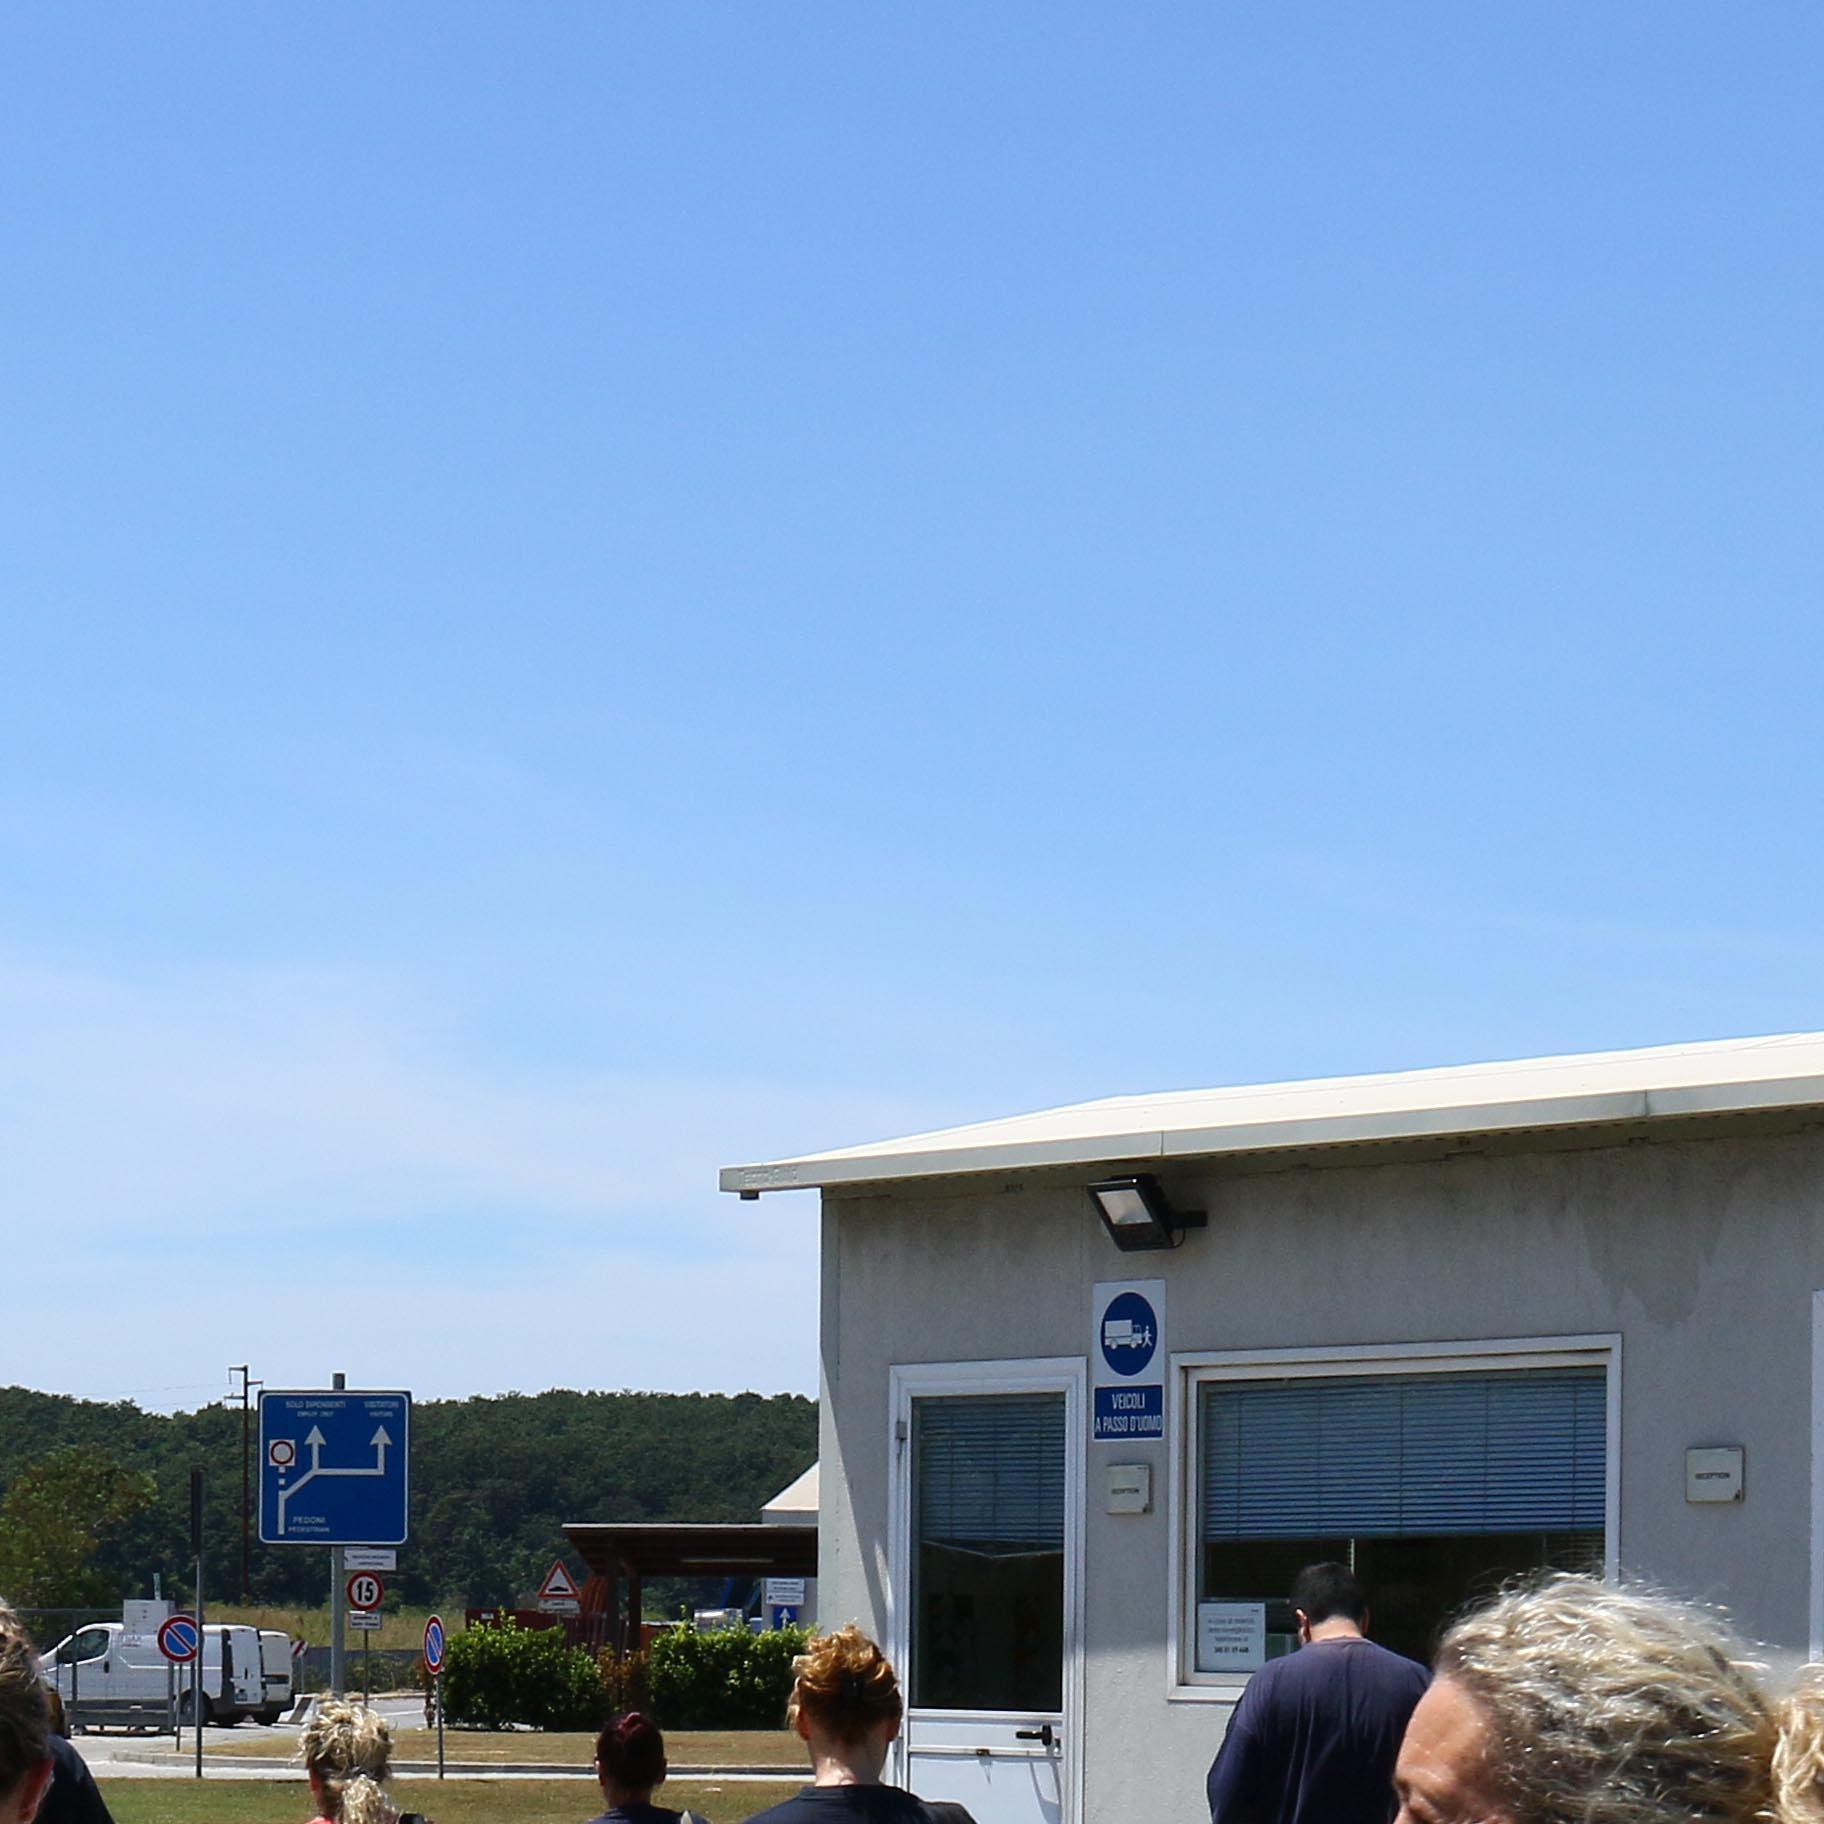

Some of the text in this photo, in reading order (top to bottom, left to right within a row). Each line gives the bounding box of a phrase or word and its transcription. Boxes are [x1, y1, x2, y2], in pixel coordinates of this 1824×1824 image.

[1111, 1392, 1146, 1410] VEICOLI
[1094, 1414, 1162, 1432] A PASSO D'UOMO
[356, 1580, 374, 1602] 15
